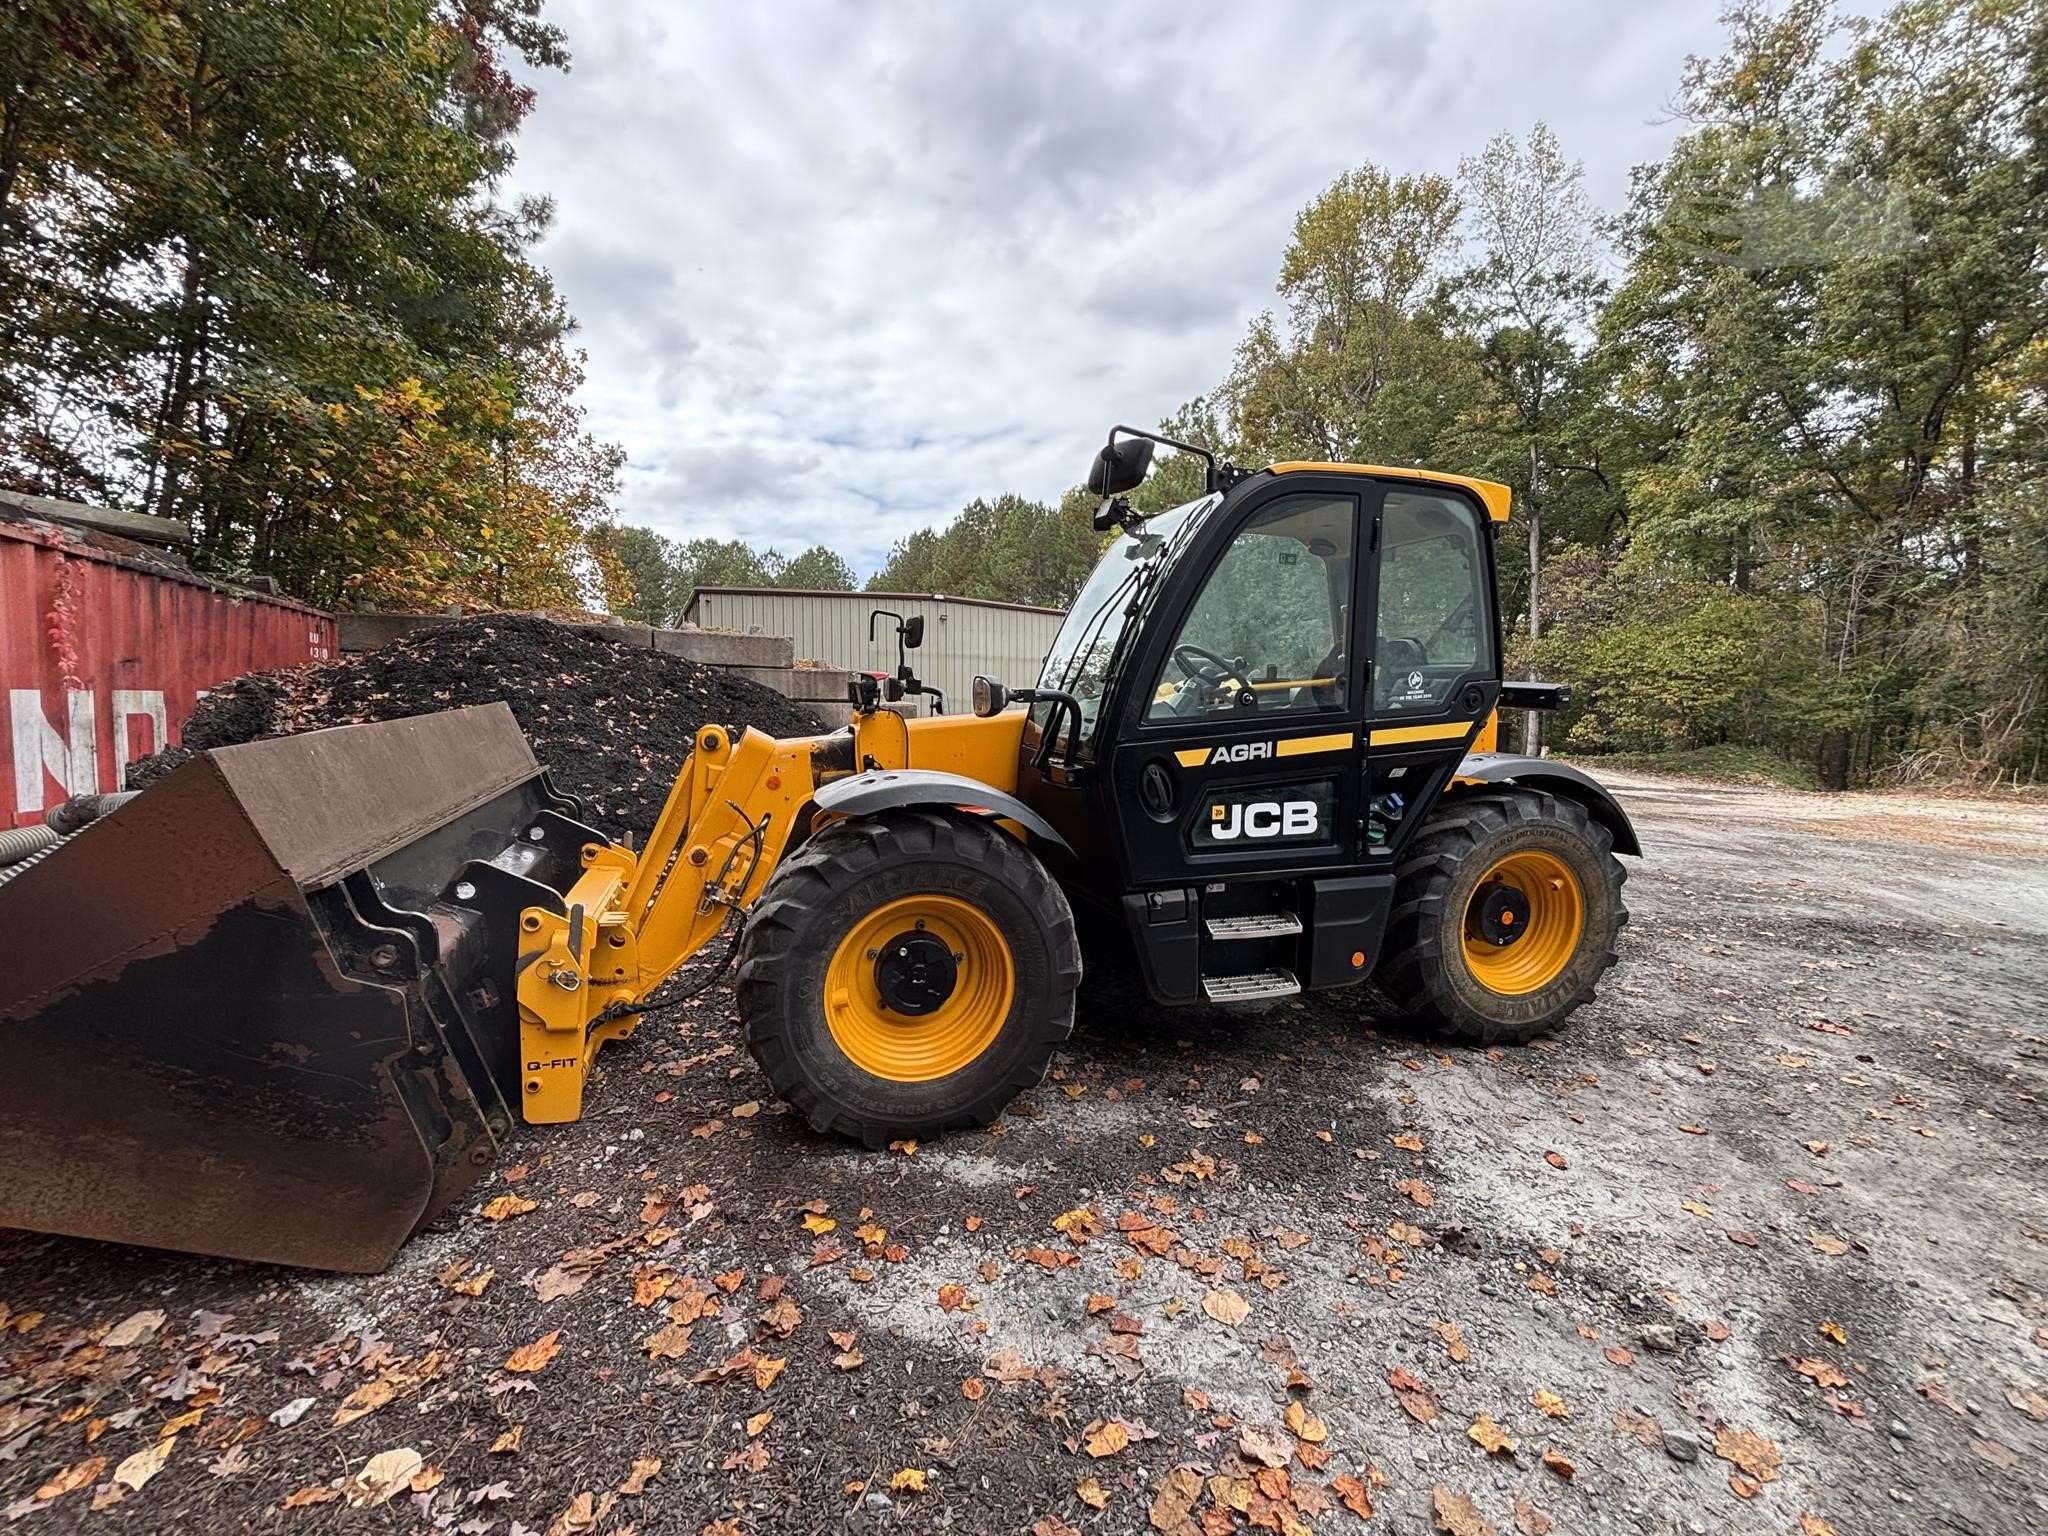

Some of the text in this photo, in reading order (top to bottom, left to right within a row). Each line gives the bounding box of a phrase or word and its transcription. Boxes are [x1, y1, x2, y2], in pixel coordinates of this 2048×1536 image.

[1210, 741, 1273, 765] AGRI
[1211, 801, 1318, 840] JCB
[527, 1057, 578, 1071] Q-FIT
